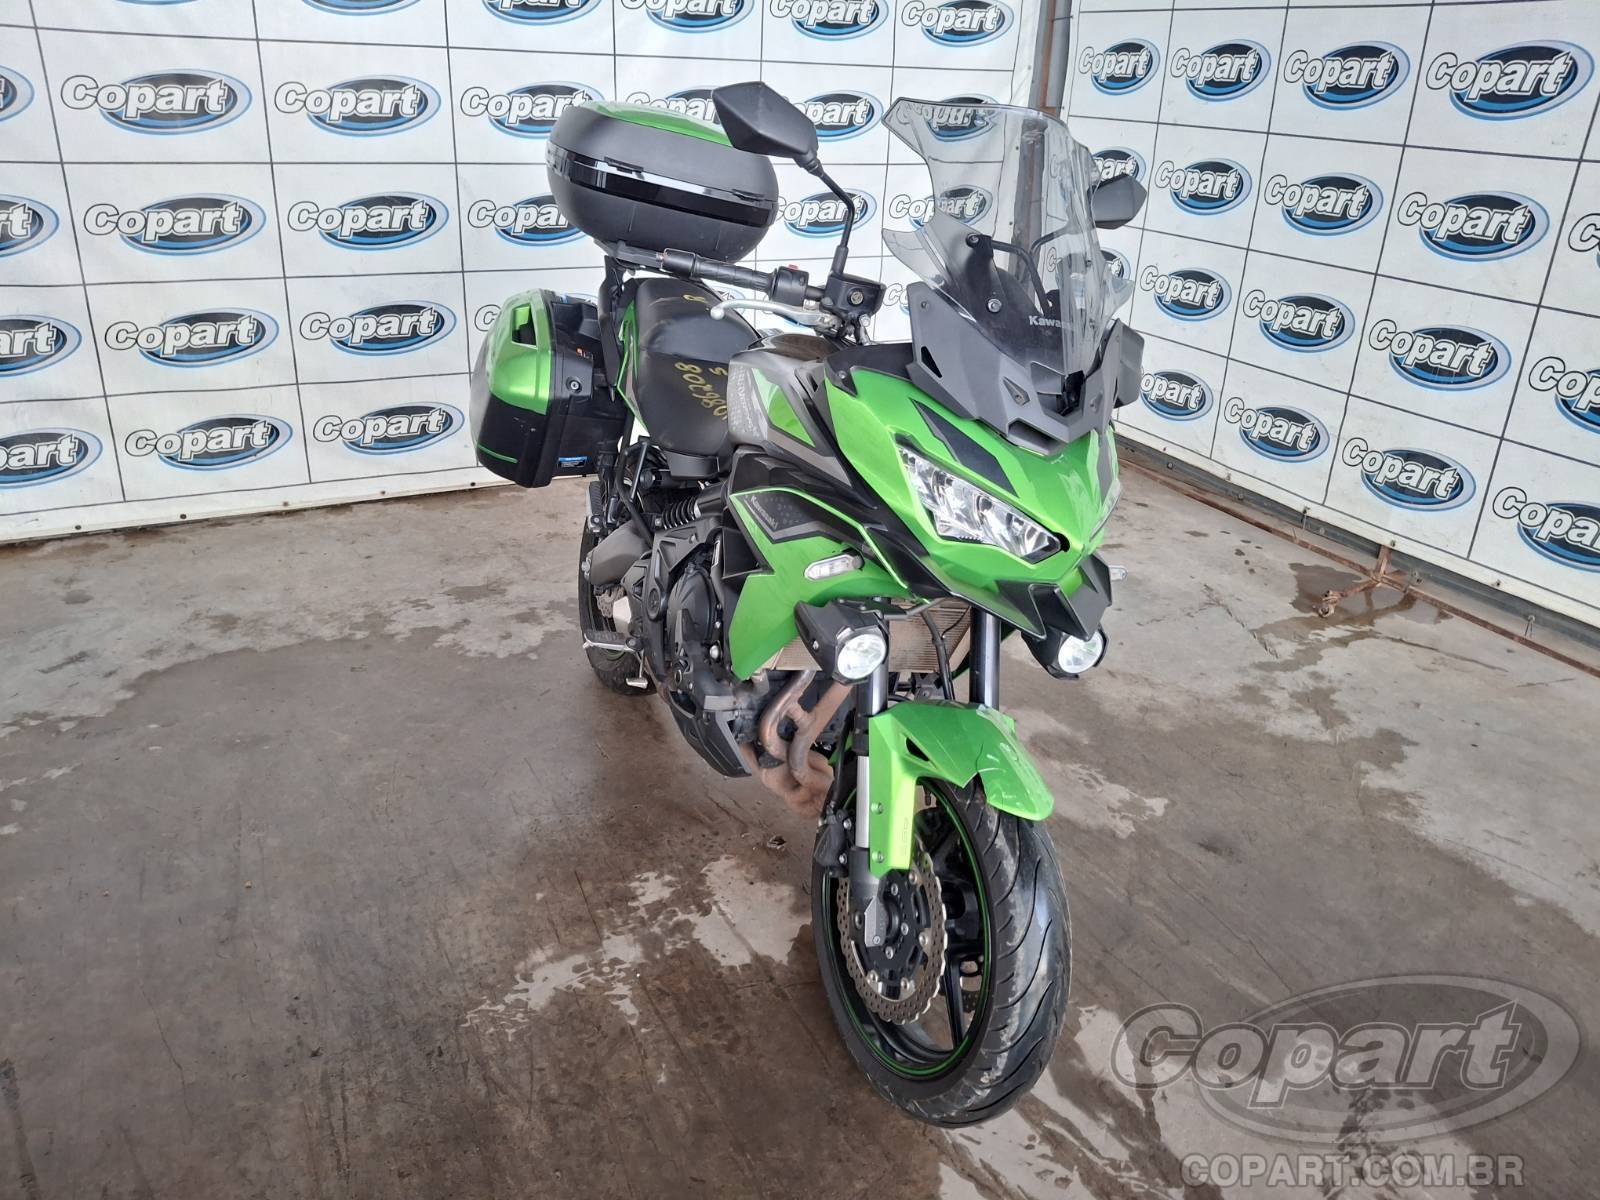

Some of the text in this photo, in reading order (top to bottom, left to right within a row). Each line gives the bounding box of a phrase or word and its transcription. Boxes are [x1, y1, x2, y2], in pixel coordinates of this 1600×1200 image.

[770, 0, 874, 27] Copart
[902, 1, 1001, 34] Copart
[1079, 46, 1150, 83] Copart
[1170, 48, 1258, 87] Copart
[1284, 50, 1395, 94] Copart
[1426, 52, 1572, 102] Copart
[61, 75, 227, 120] Copart
[275, 82, 421, 123] Copart
[1155, 160, 1241, 200] Copart
[1264, 174, 1370, 218] Copart
[84, 202, 243, 242] Copart
[288, 201, 428, 238] Copart
[468, 200, 570, 236] Copar
[1397, 192, 1532, 243] Copart
[1140, 265, 1221, 308] Copart
[300, 306, 437, 346] Copart
[1243, 289, 1344, 340] Copart
[105, 315, 257, 358] Copart
[1369, 319, 1494, 377] Copart
[1139, 372, 1202, 409] opart
[125, 420, 276, 461] Copart
[313, 408, 447, 447] Copart
[1224, 397, 1318, 451] Copart
[1342, 437, 1459, 498] Copart
